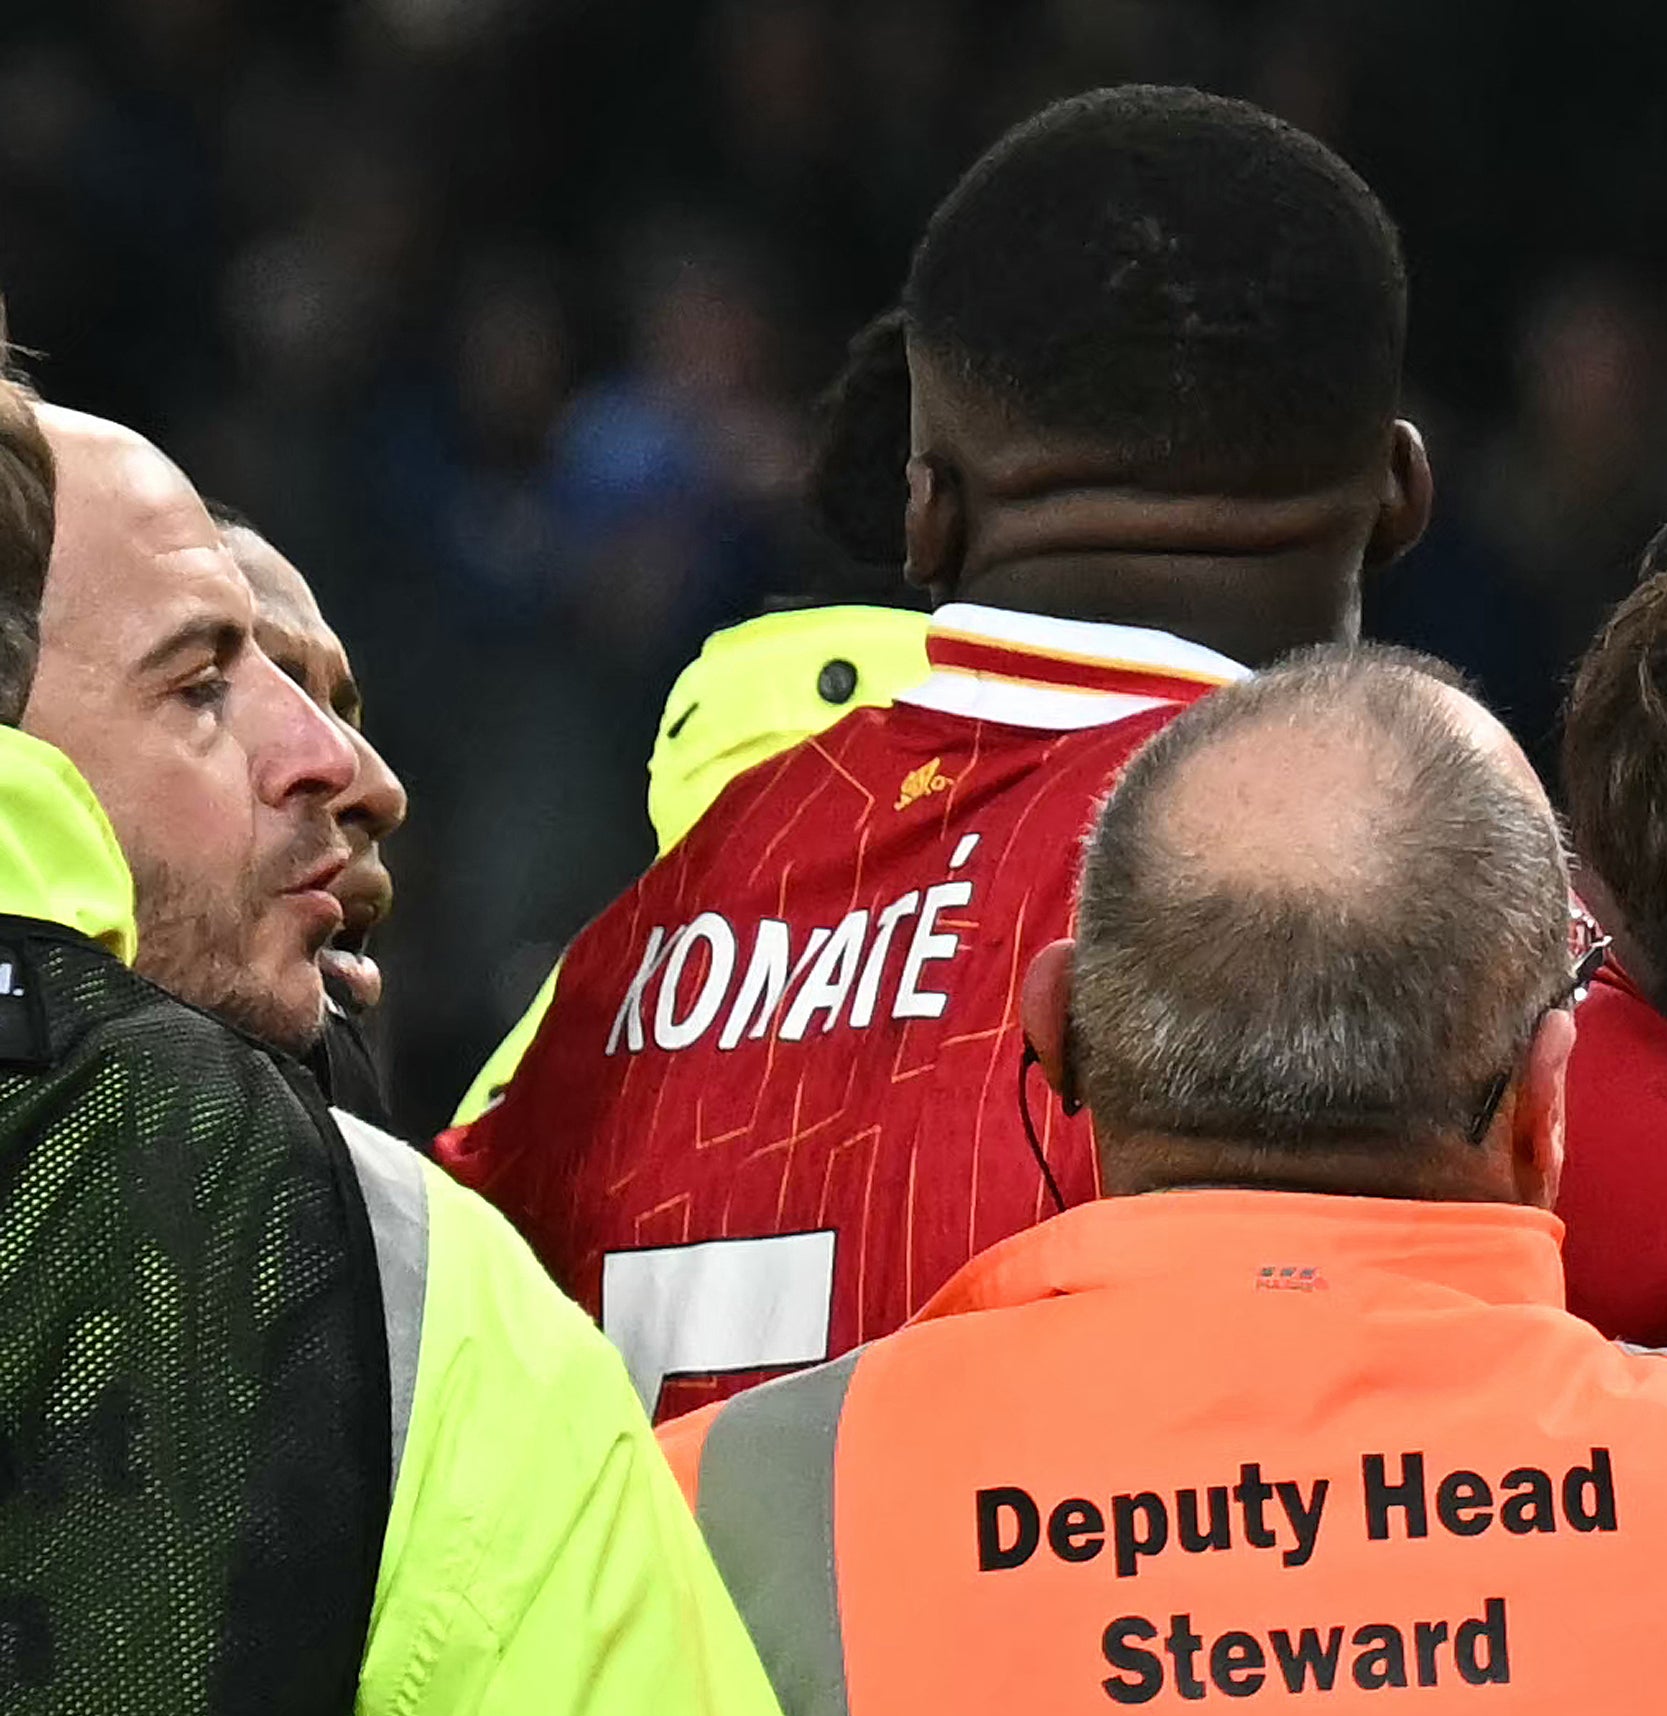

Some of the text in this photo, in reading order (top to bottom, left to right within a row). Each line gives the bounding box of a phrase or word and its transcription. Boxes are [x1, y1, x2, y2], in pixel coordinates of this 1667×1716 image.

[605, 833, 981, 1056] KONATÉ
[974, 1446, 1618, 1578] Deputy Head
[1100, 1597, 1511, 1705] Steward
